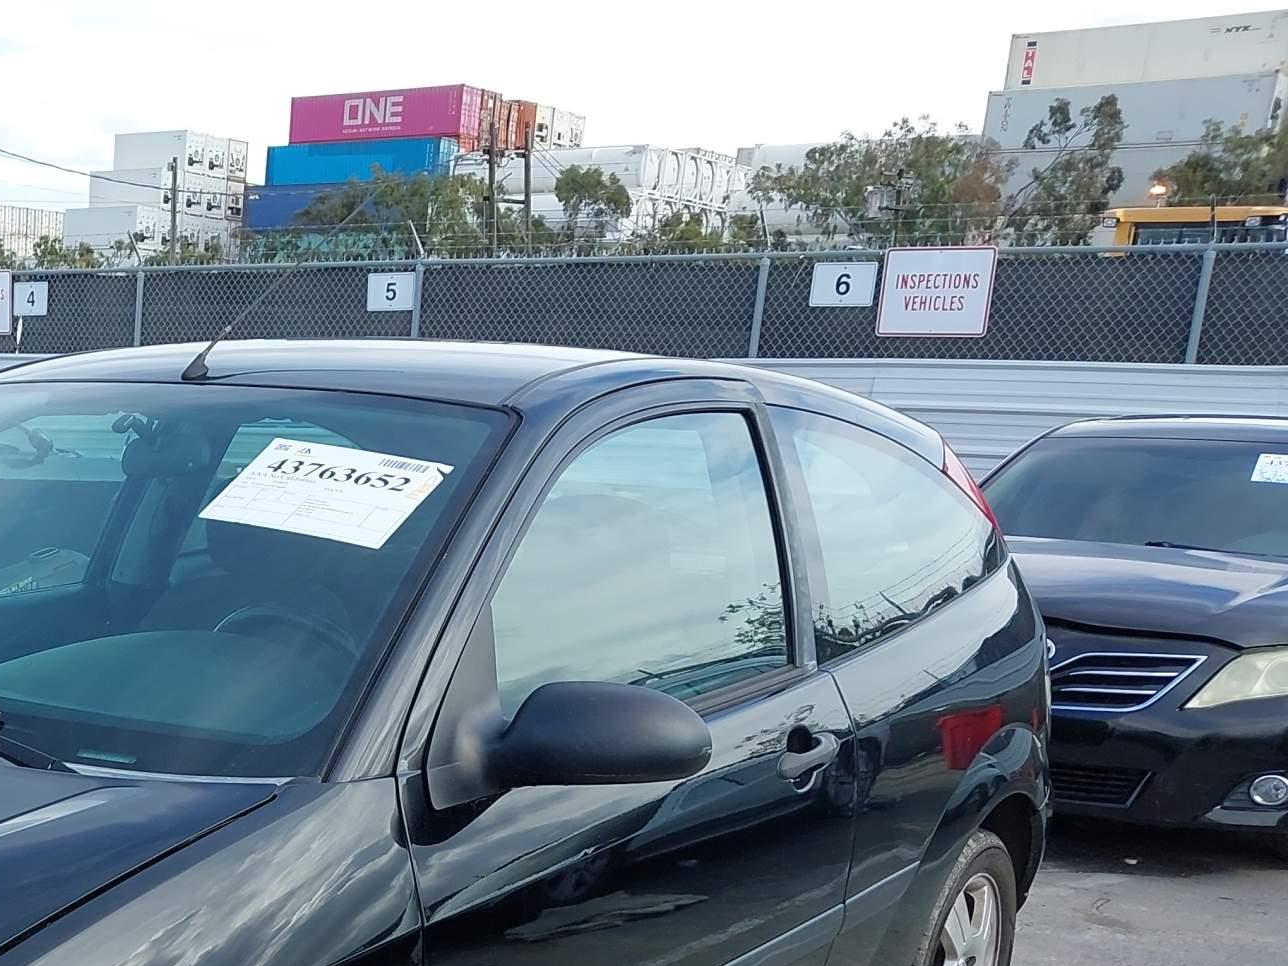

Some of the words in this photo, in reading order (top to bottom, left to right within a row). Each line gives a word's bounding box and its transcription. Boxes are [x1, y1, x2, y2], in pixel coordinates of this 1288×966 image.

[343, 96, 404, 126] ONE
[835, 273, 852, 296] 6
[895, 273, 980, 290] INSPECTIONS
[26, 290, 36, 307] 4
[385, 282, 397, 301] 5
[904, 295, 965, 312] VEHICLES
[266, 458, 412, 492] 43763652
